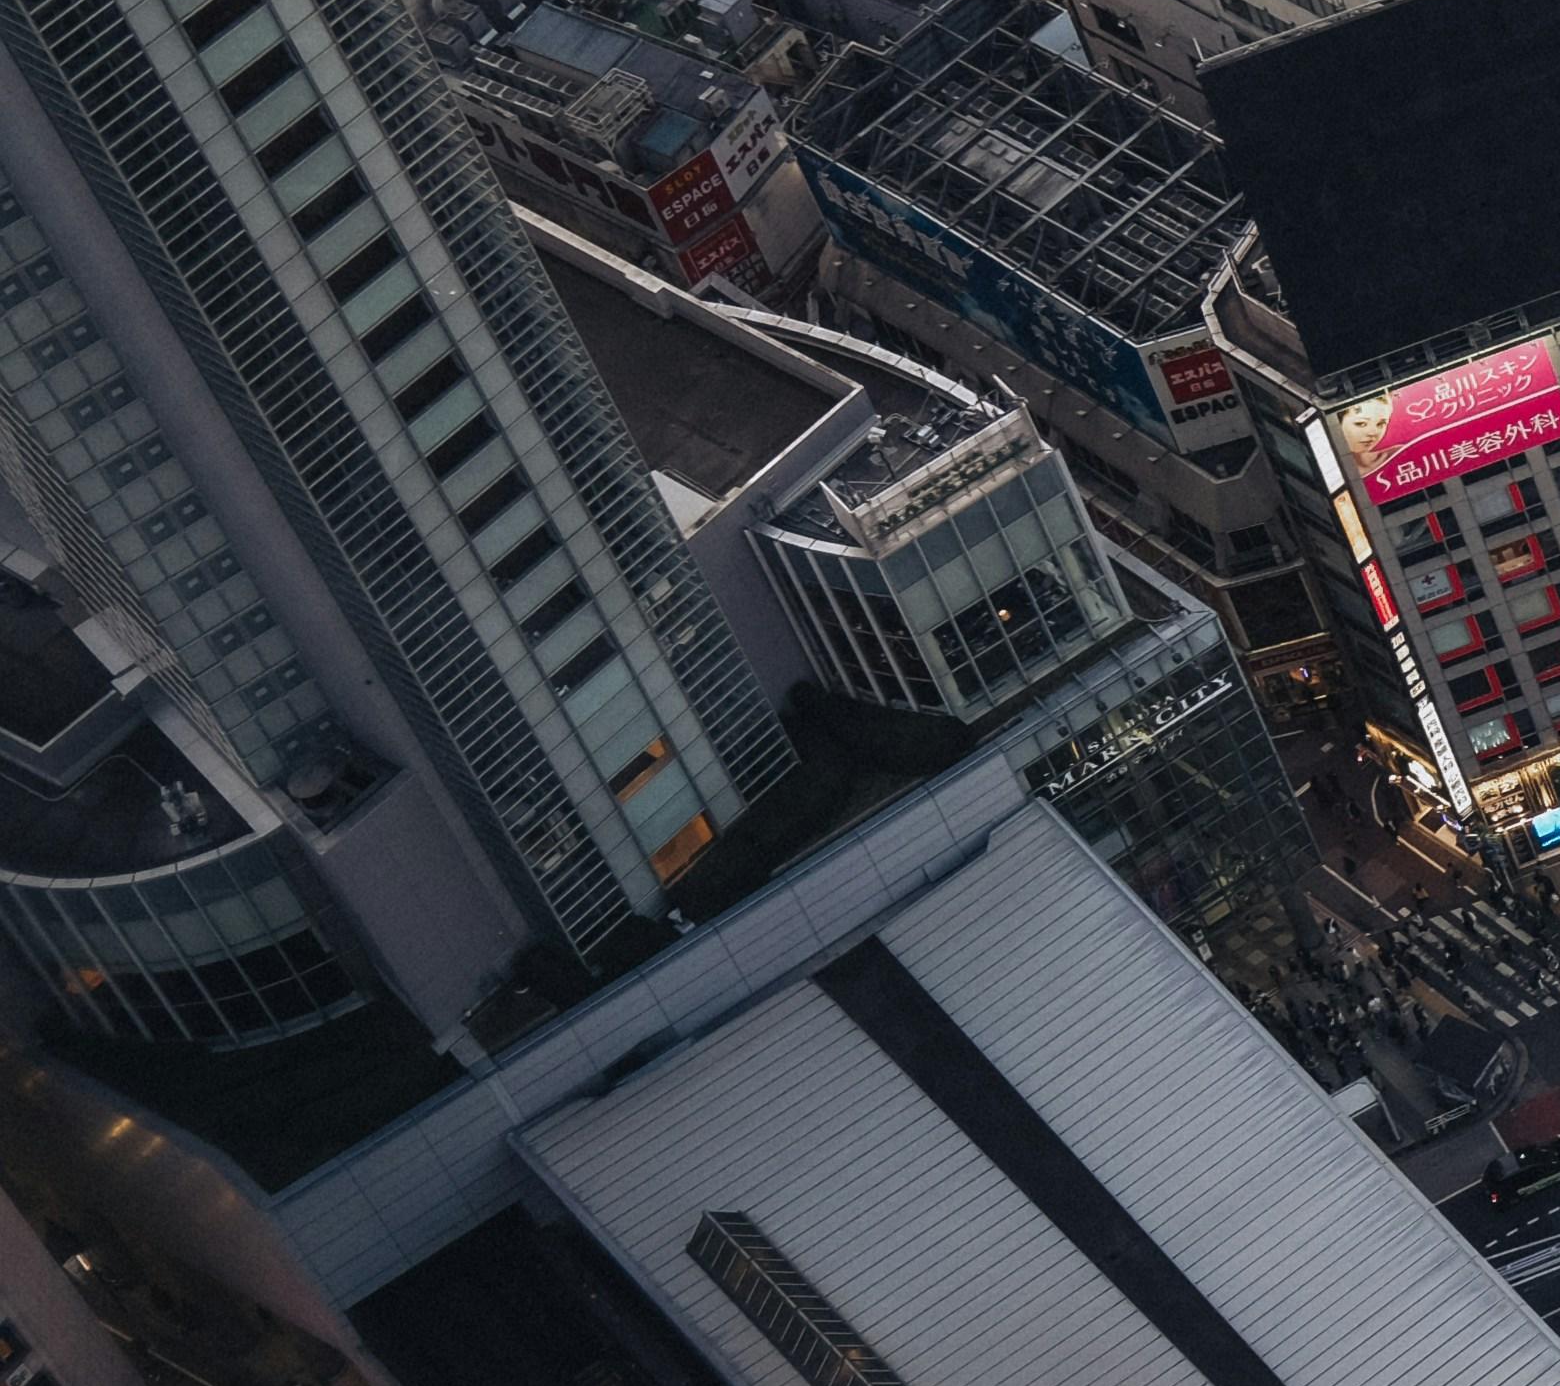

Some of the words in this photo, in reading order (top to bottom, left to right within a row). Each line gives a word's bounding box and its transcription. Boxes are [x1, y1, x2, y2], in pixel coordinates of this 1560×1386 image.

[1433, 354, 1537, 400] 品川スキン
[1440, 373, 1533, 420] クリニック
[1155, 671, 1229, 726] CITY
